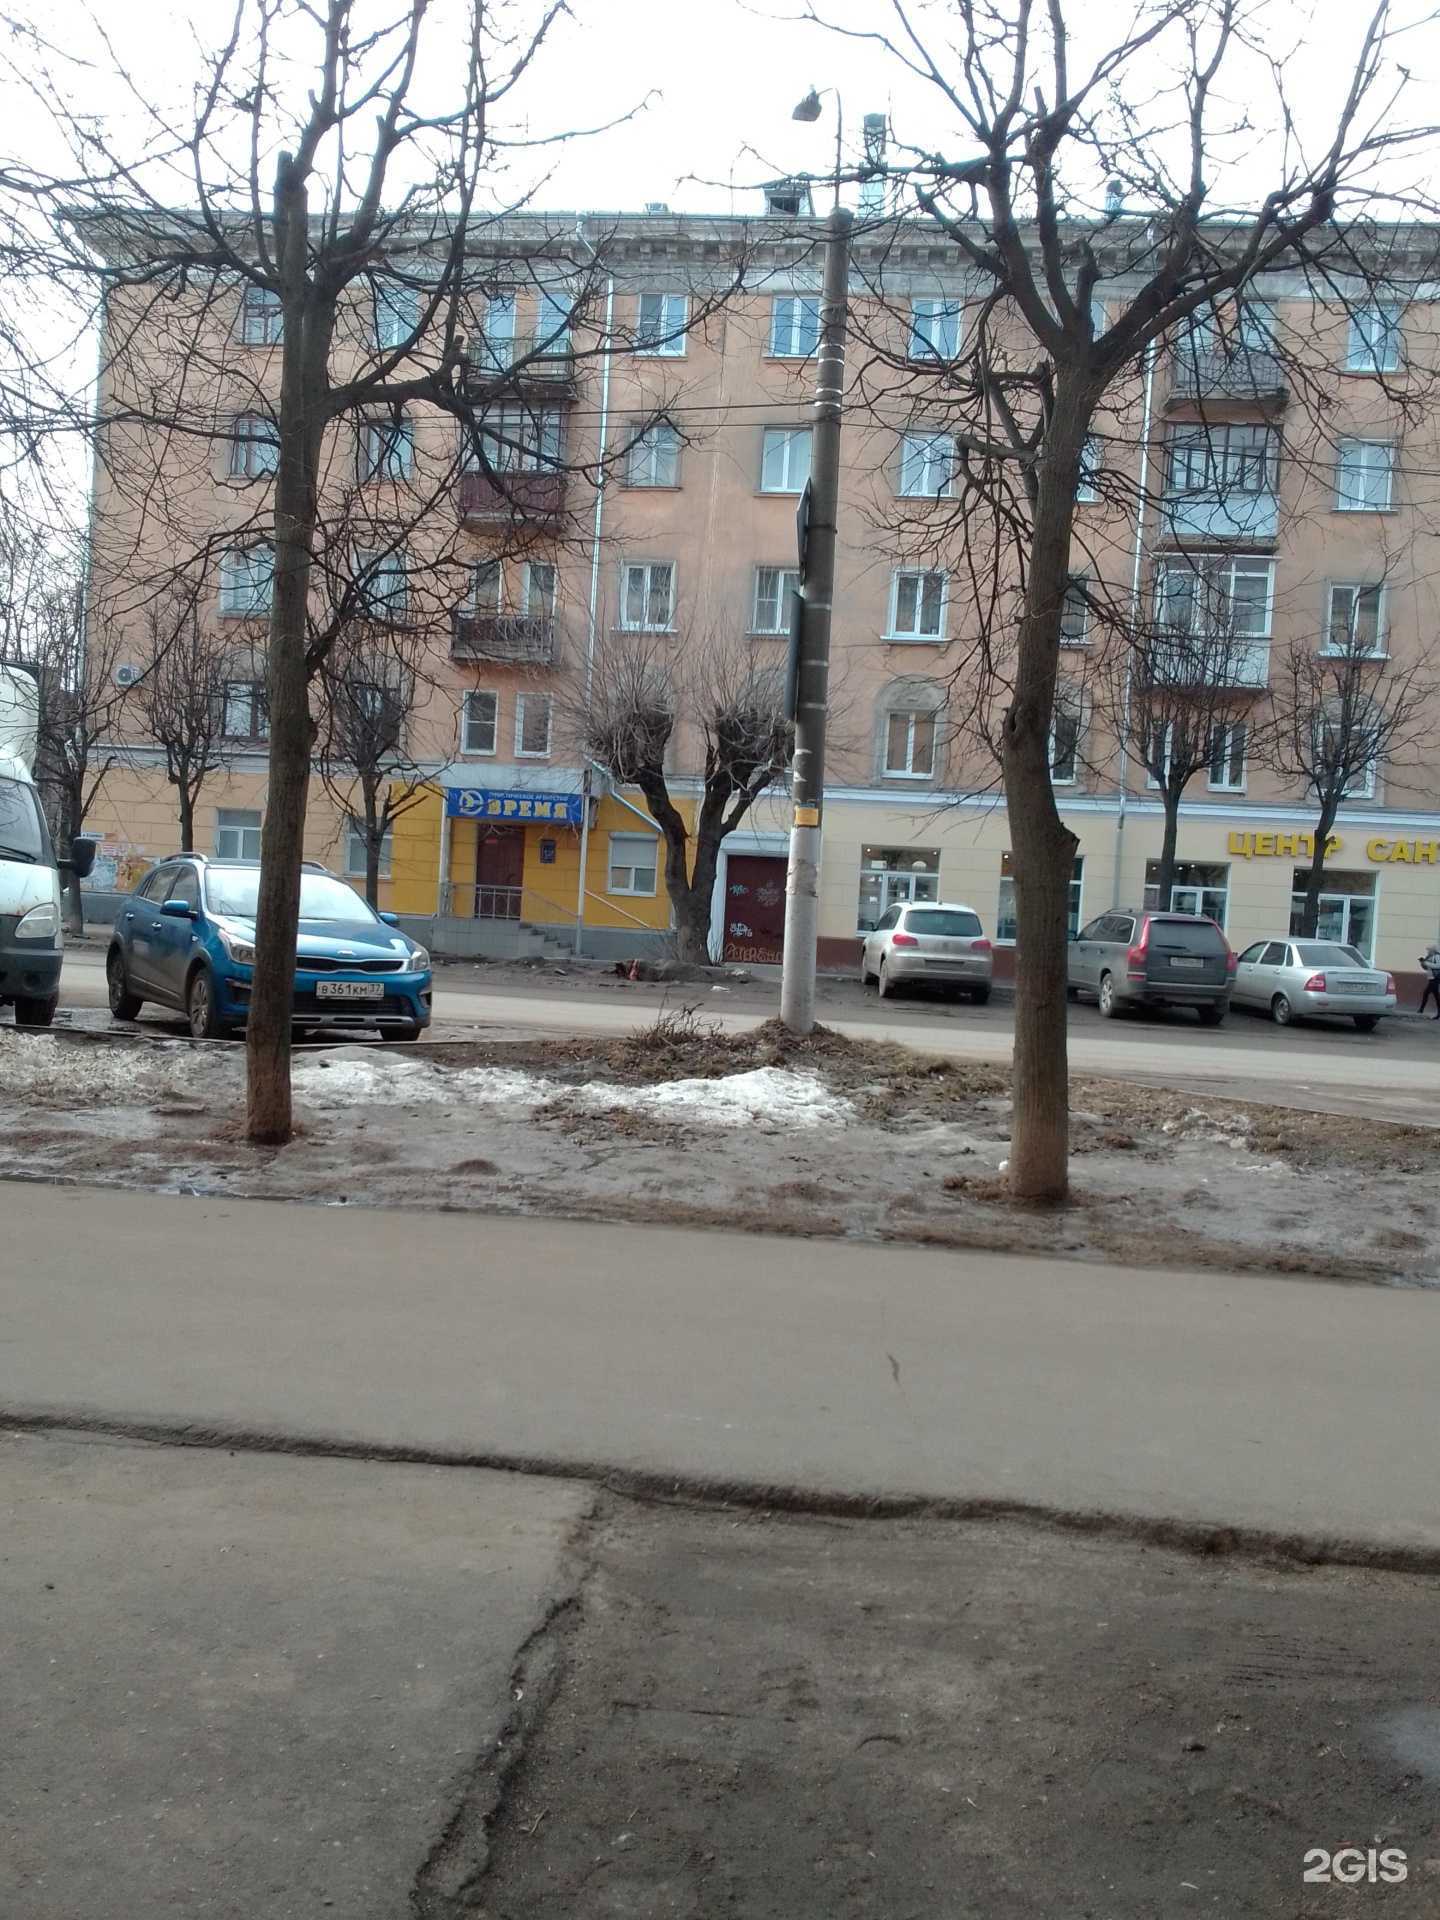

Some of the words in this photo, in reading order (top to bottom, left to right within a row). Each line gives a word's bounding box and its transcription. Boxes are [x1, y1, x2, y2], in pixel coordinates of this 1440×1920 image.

[487, 798, 568, 818] ВРЕМЯ
[1229, 831, 1344, 858] ЦЕНТР
[1367, 838, 1440, 864] САН
